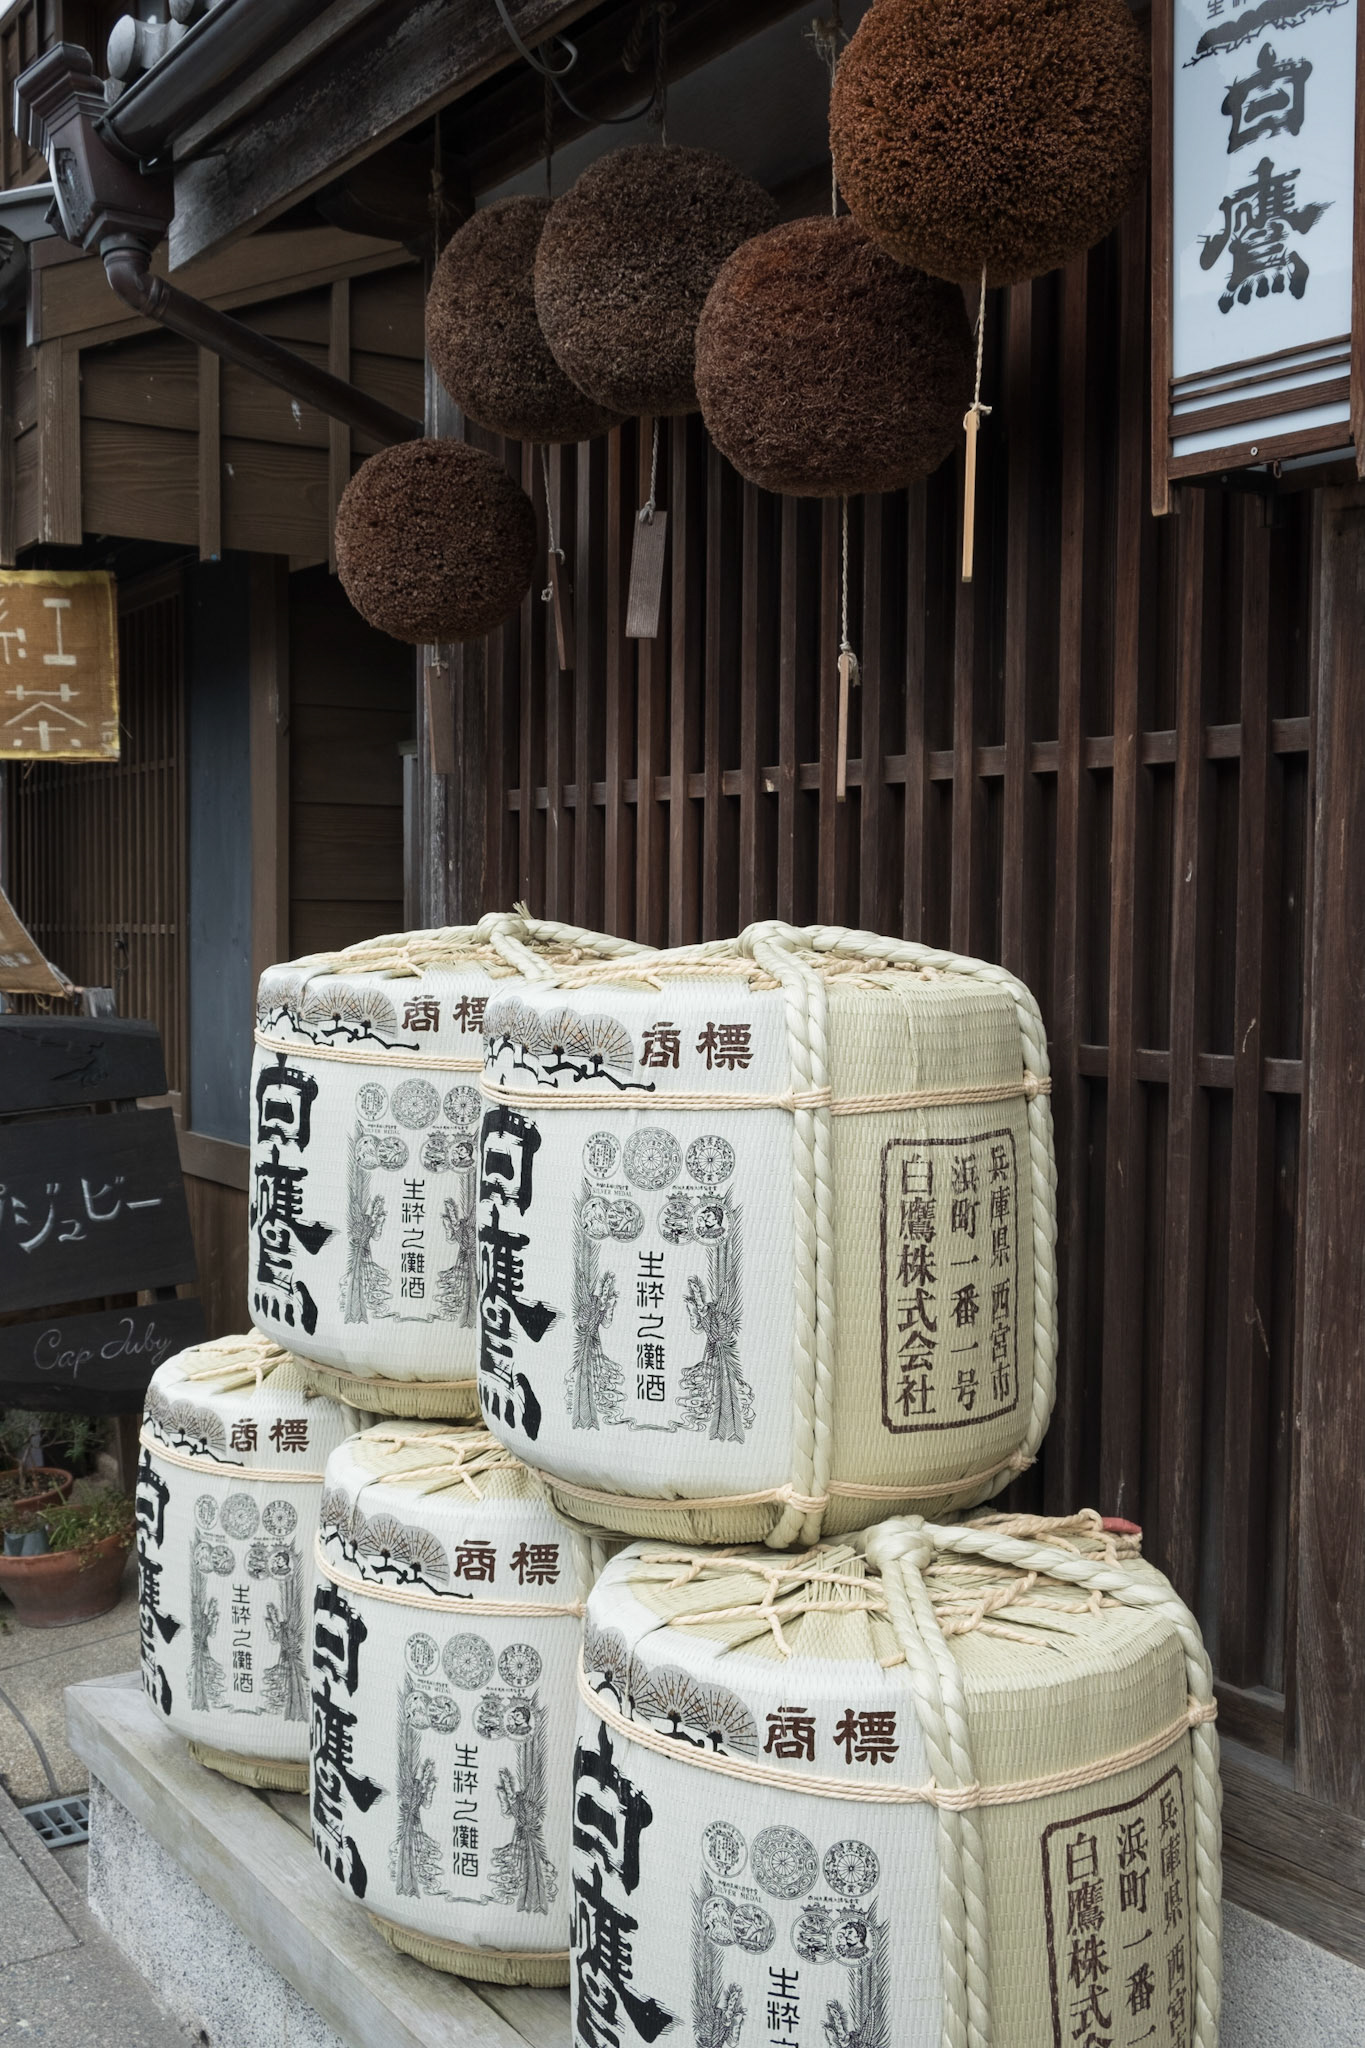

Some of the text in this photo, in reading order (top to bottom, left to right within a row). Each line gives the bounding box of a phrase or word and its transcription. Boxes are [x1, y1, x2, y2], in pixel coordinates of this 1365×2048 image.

[1198, 42, 1334, 314] 白鷹
[639, 1021, 754, 1071] 商標
[0, 1176, 162, 1253] ジュビー
[896, 1154, 938, 1416] 白鷹株式会社
[950, 1154, 981, 1411] 浜町一番一号
[989, 1145, 1011, 1402] 兵庫県西宮市
[34, 1329, 94, 1379] Cap
[229, 1418, 310, 1453] 商標
[454, 1539, 561, 1586] 商標
[763, 1705, 900, 1766] 商標
